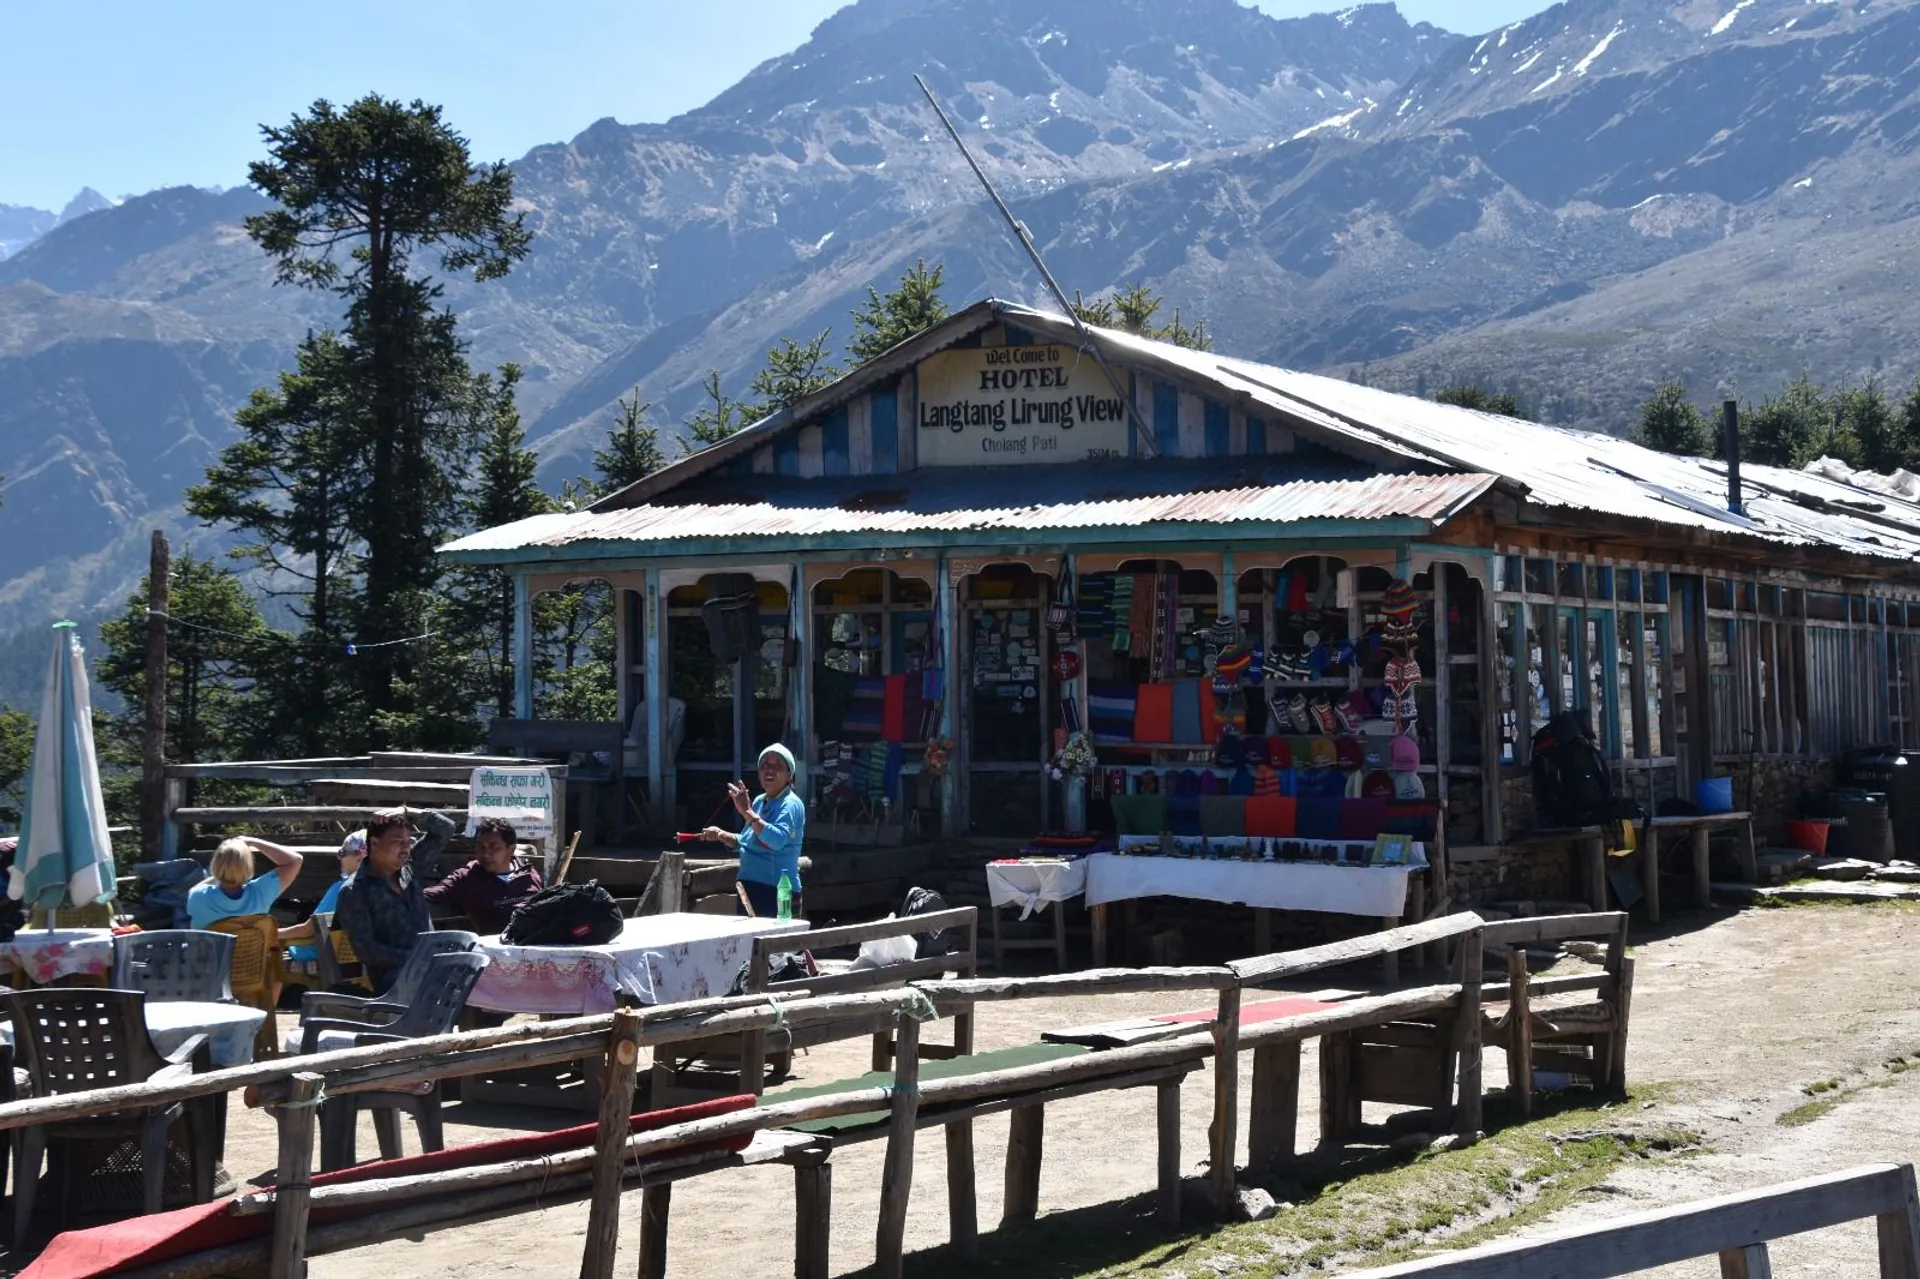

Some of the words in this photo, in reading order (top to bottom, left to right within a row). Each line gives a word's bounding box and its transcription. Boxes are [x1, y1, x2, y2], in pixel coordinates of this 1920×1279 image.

[1013, 348, 1044, 364] Come
[1048, 348, 1060, 362] to
[979, 367, 1069, 390] HOTEL
[920, 399, 1006, 433] Langtang
[1011, 396, 1074, 429] Lirung
[1076, 395, 1124, 422] View
[982, 436, 1027, 454] Cholang
